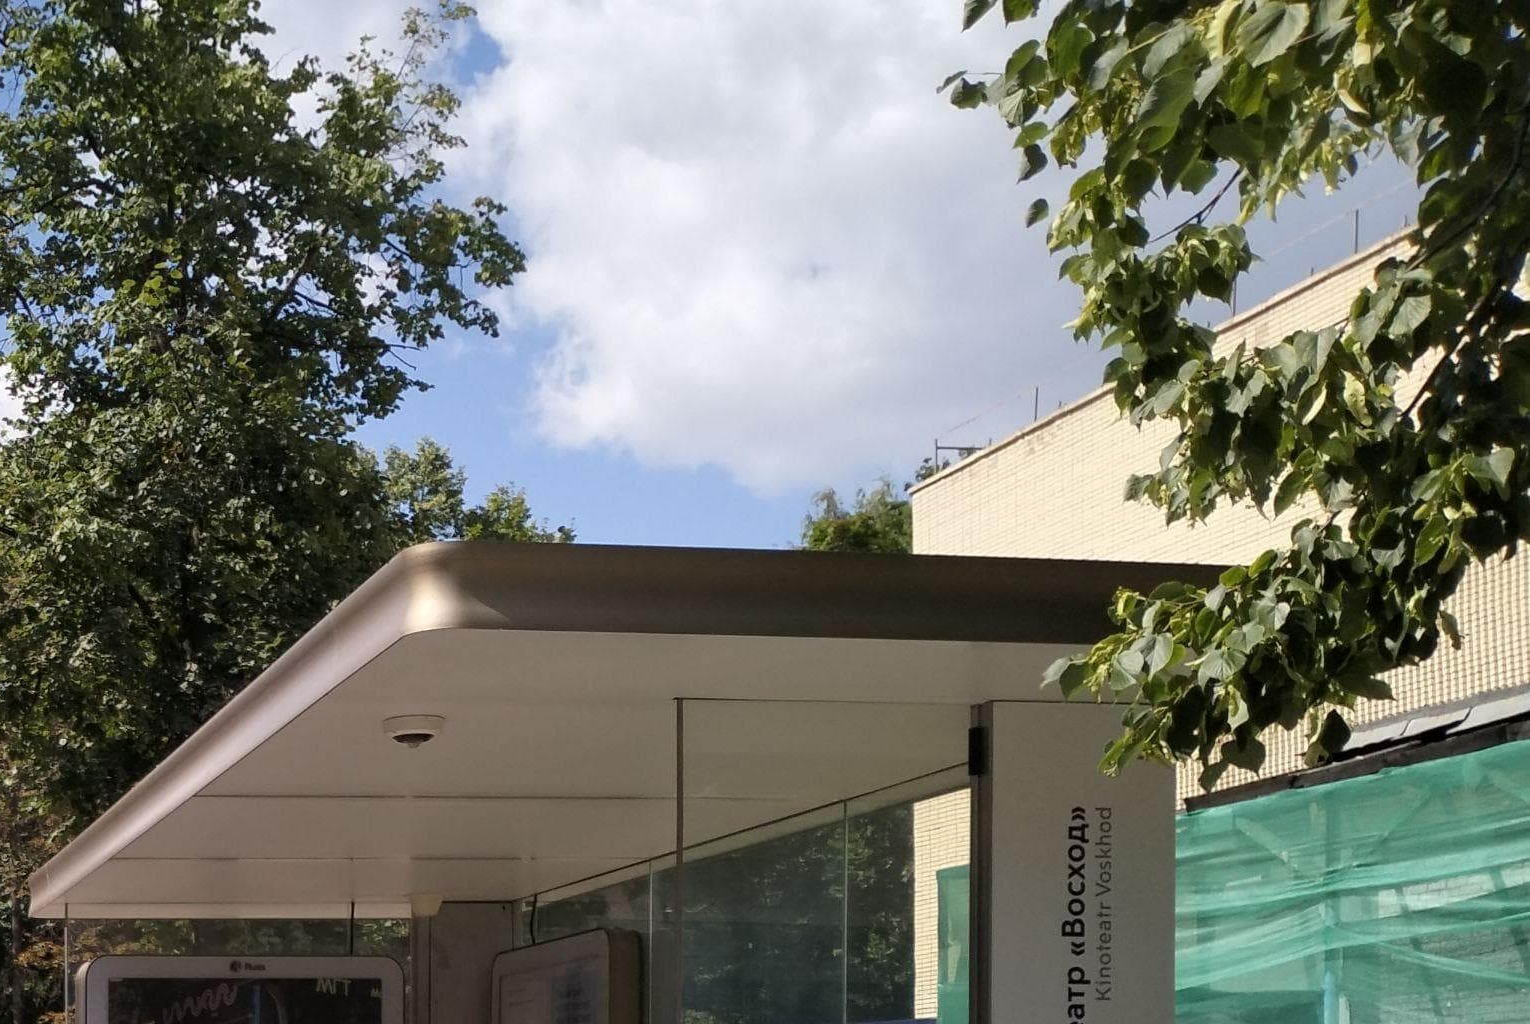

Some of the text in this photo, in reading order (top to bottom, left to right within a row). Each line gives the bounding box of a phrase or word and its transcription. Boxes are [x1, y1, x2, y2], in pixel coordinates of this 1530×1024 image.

[1061, 806, 1089, 957] «Восход»
[1095, 807, 1112, 1001] Kinoteatr Voskhod
